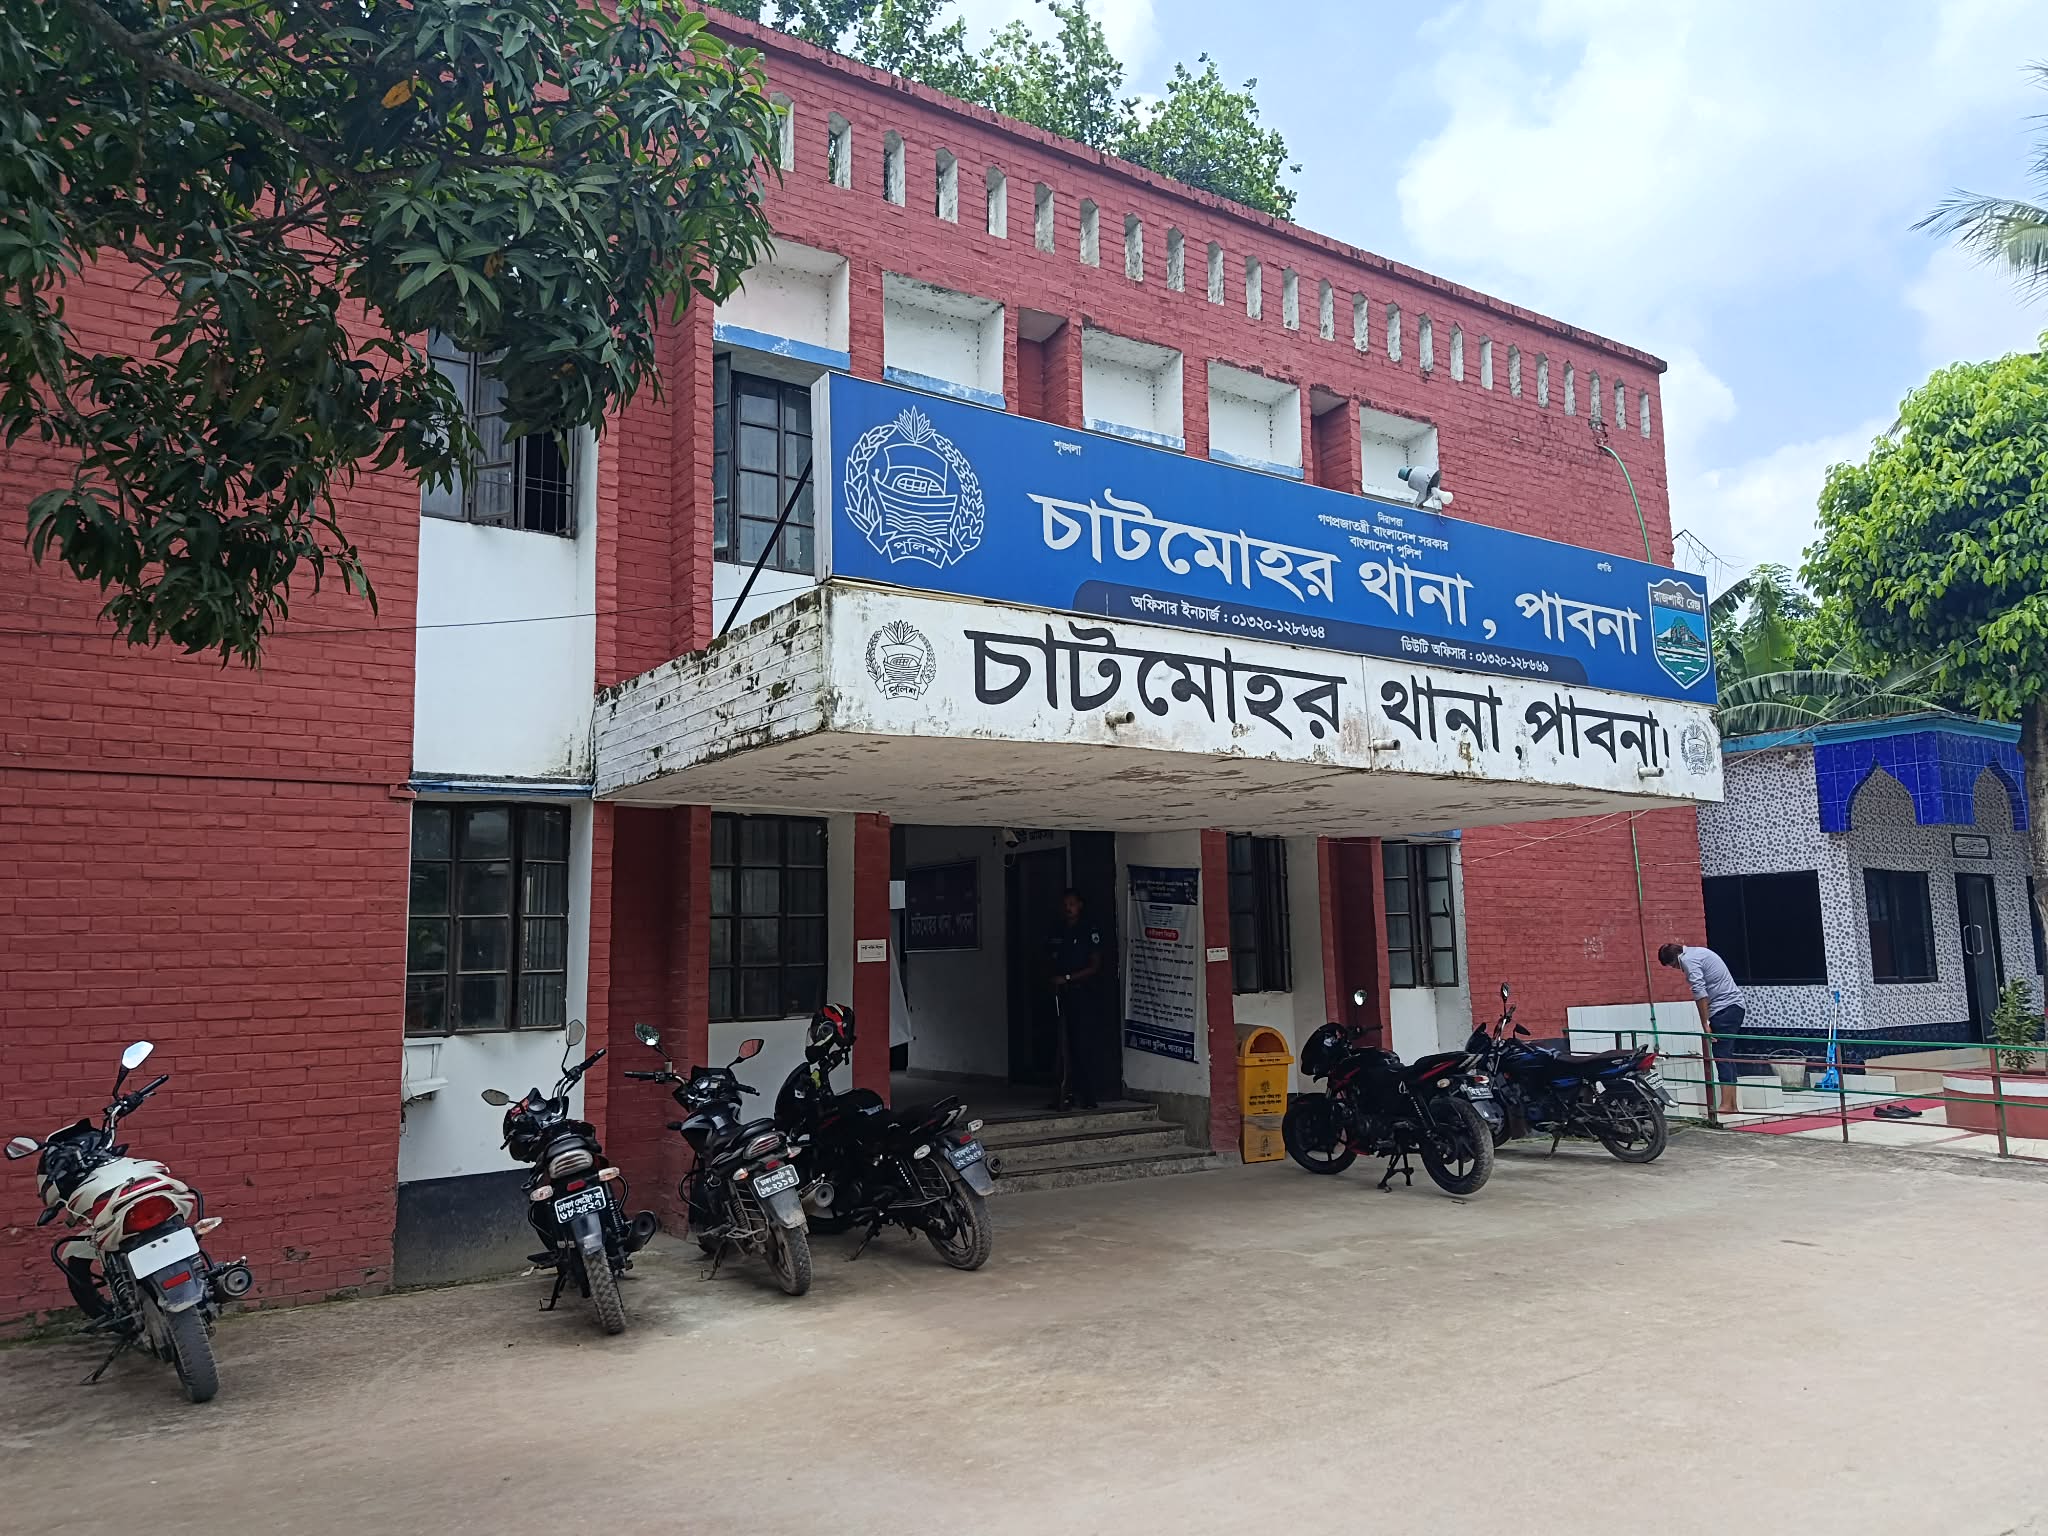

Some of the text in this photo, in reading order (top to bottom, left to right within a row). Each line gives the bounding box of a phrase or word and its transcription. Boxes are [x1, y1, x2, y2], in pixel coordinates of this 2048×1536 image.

[894, 538, 940, 559] পুলিশ
[1318, 514, 1449, 551] গণপ্রজাতন্ত্রী বাংলাদেশ সরকার
[1349, 535, 1422, 560] বাংলাদেশ পুলিশ
[1026, 488, 1342, 602] চাটমোহর
[1515, 589, 1642, 655] পাবনা
[1130, 594, 1178, 616] অফিসার
[1181, 600, 1221, 623] ইনচার্জ
[1231, 613, 1326, 639] ০১৩২০-১২৮৬৬৪
[1653, 591, 1684, 608] রাজশাহী
[1401, 635, 1429, 654] ডিউটি
[1431, 642, 1466, 660] অফিসার
[1476, 652, 1549, 673] ০১৩২০-১২৮৬৬৯
[963, 621, 1347, 740] চাটমোহর
[558, 1200, 574, 1212] ঢাকা
